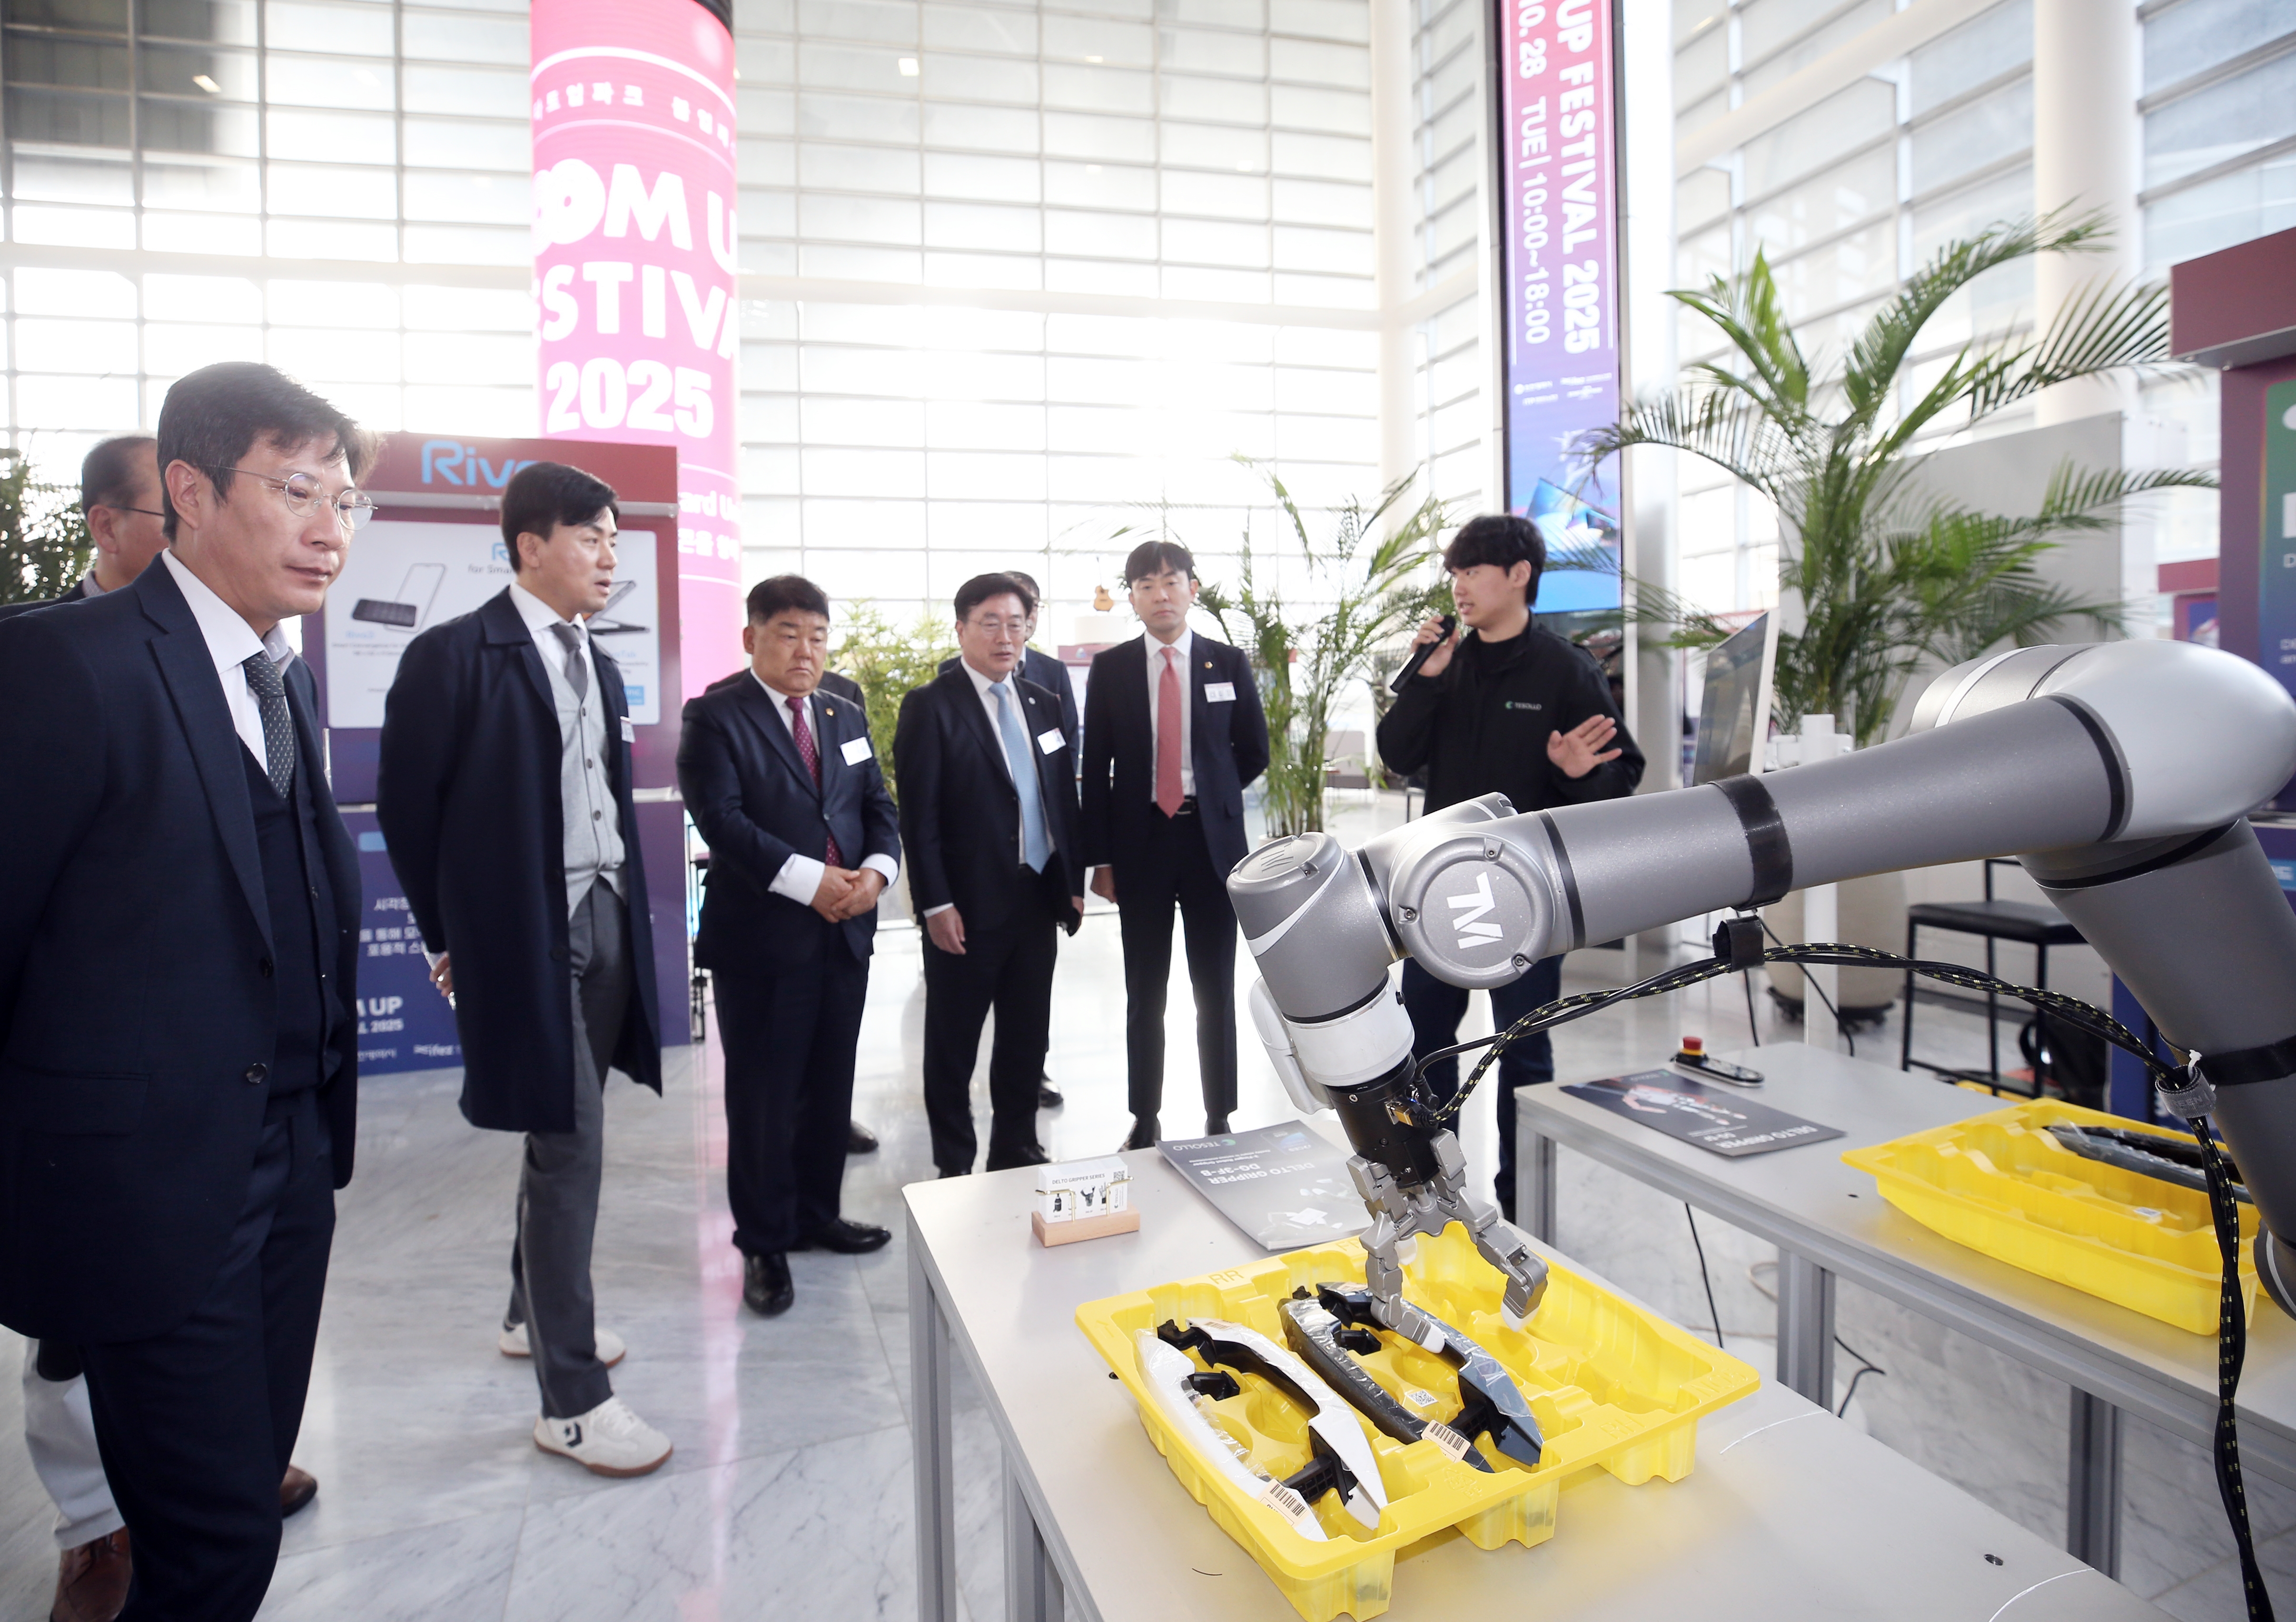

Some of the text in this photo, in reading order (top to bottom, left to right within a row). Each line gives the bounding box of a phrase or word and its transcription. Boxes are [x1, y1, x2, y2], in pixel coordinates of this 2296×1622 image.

[1556, 0, 1593, 53] UP
[1558, 60, 1597, 255] FESTIVAL
[1562, 259, 1600, 354] 2025
[546, 357, 714, 438] 2025
[421, 440, 541, 487] Riv
[1514, 702, 1542, 711] TESOLLO
[368, 996, 404, 1016] UP
[370, 1018, 404, 1033] 2025
[1173, 1141, 1221, 1151] TESOLLO
[1200, 1163, 1261, 1177] DG-3F-B
[1207, 1162, 1315, 1185] DELTO GRIPPER
[1207, 1270, 1244, 1285] RR
